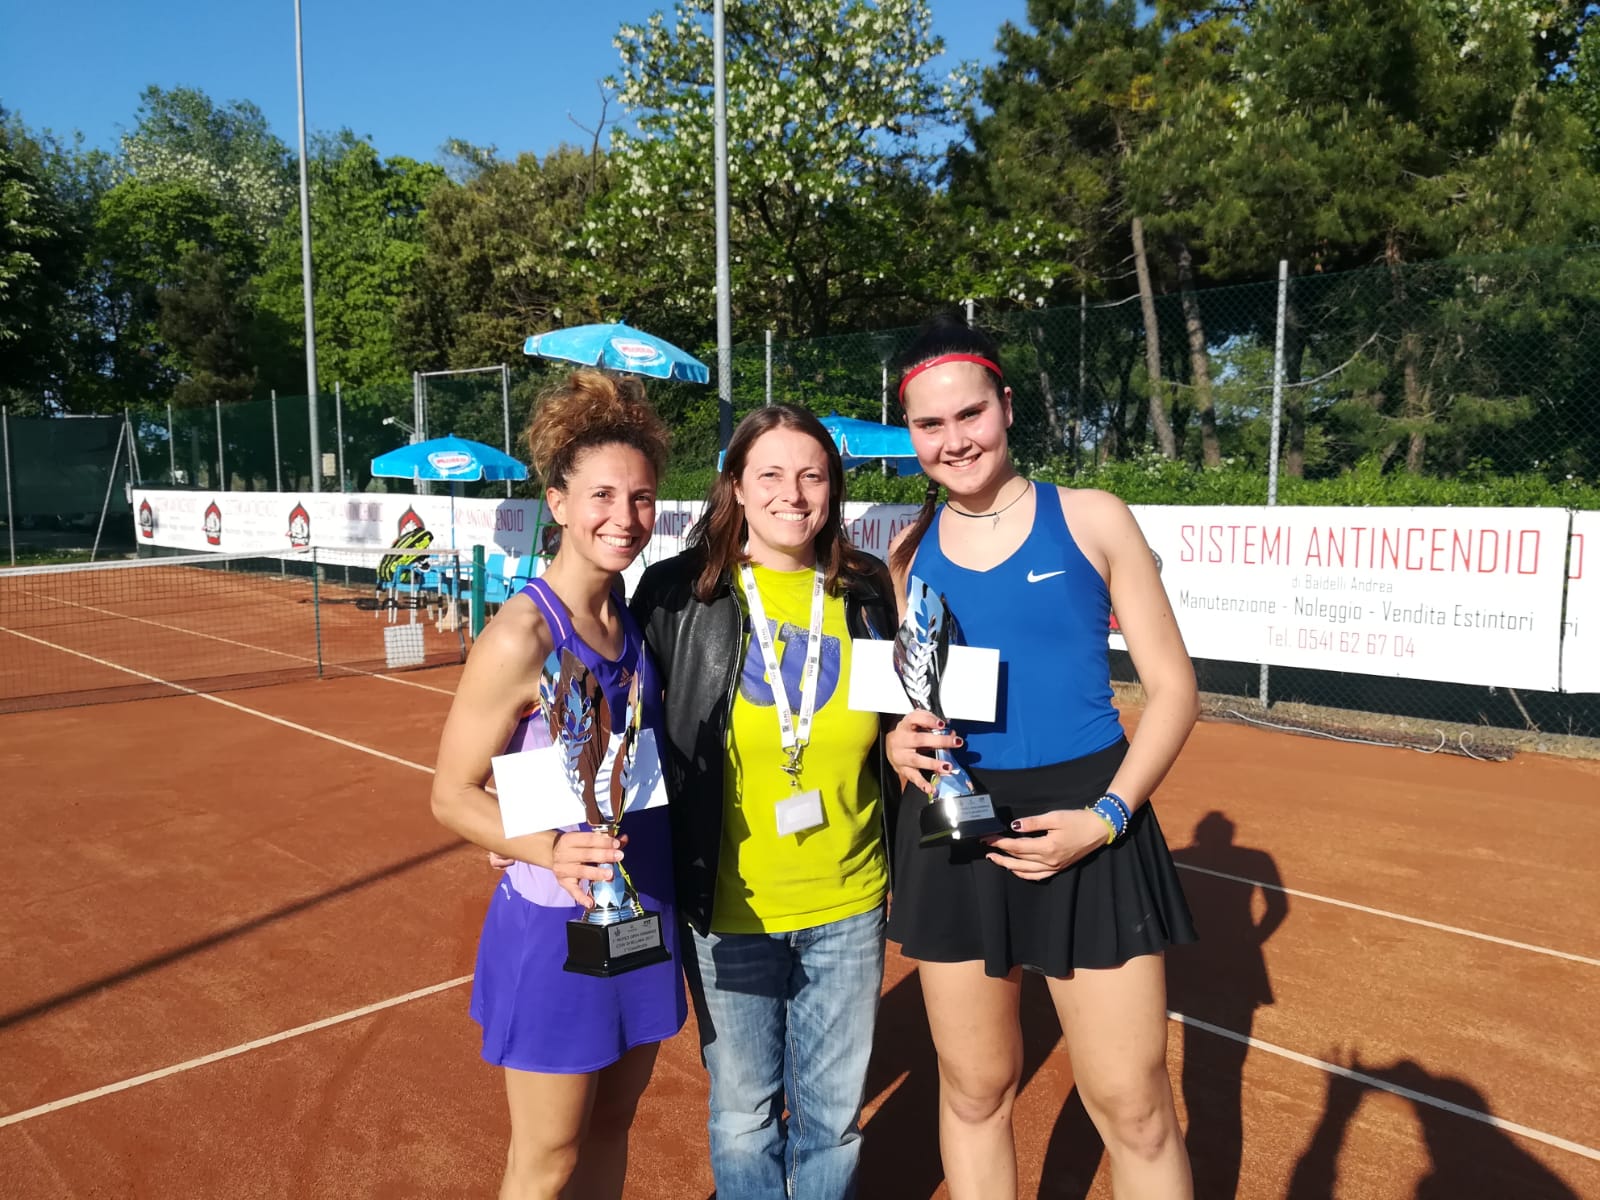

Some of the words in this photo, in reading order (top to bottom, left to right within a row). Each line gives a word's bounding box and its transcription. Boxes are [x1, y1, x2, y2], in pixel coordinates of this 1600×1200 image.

[1180, 525, 1292, 566] SISTEMI
[1305, 526, 1541, 575] ANTINCENDIO
[1350, 576, 1393, 593] Andrea
[1179, 589, 1276, 615] Manutenzione
[1294, 596, 1362, 624] Noleggio
[1382, 600, 1446, 626] Vendita
[1454, 604, 1534, 631] Estintori
[1298, 628, 1334, 651] 0541
[1339, 631, 1360, 654] 62
[1366, 633, 1388, 656] 67
[1393, 635, 1415, 658] 04
